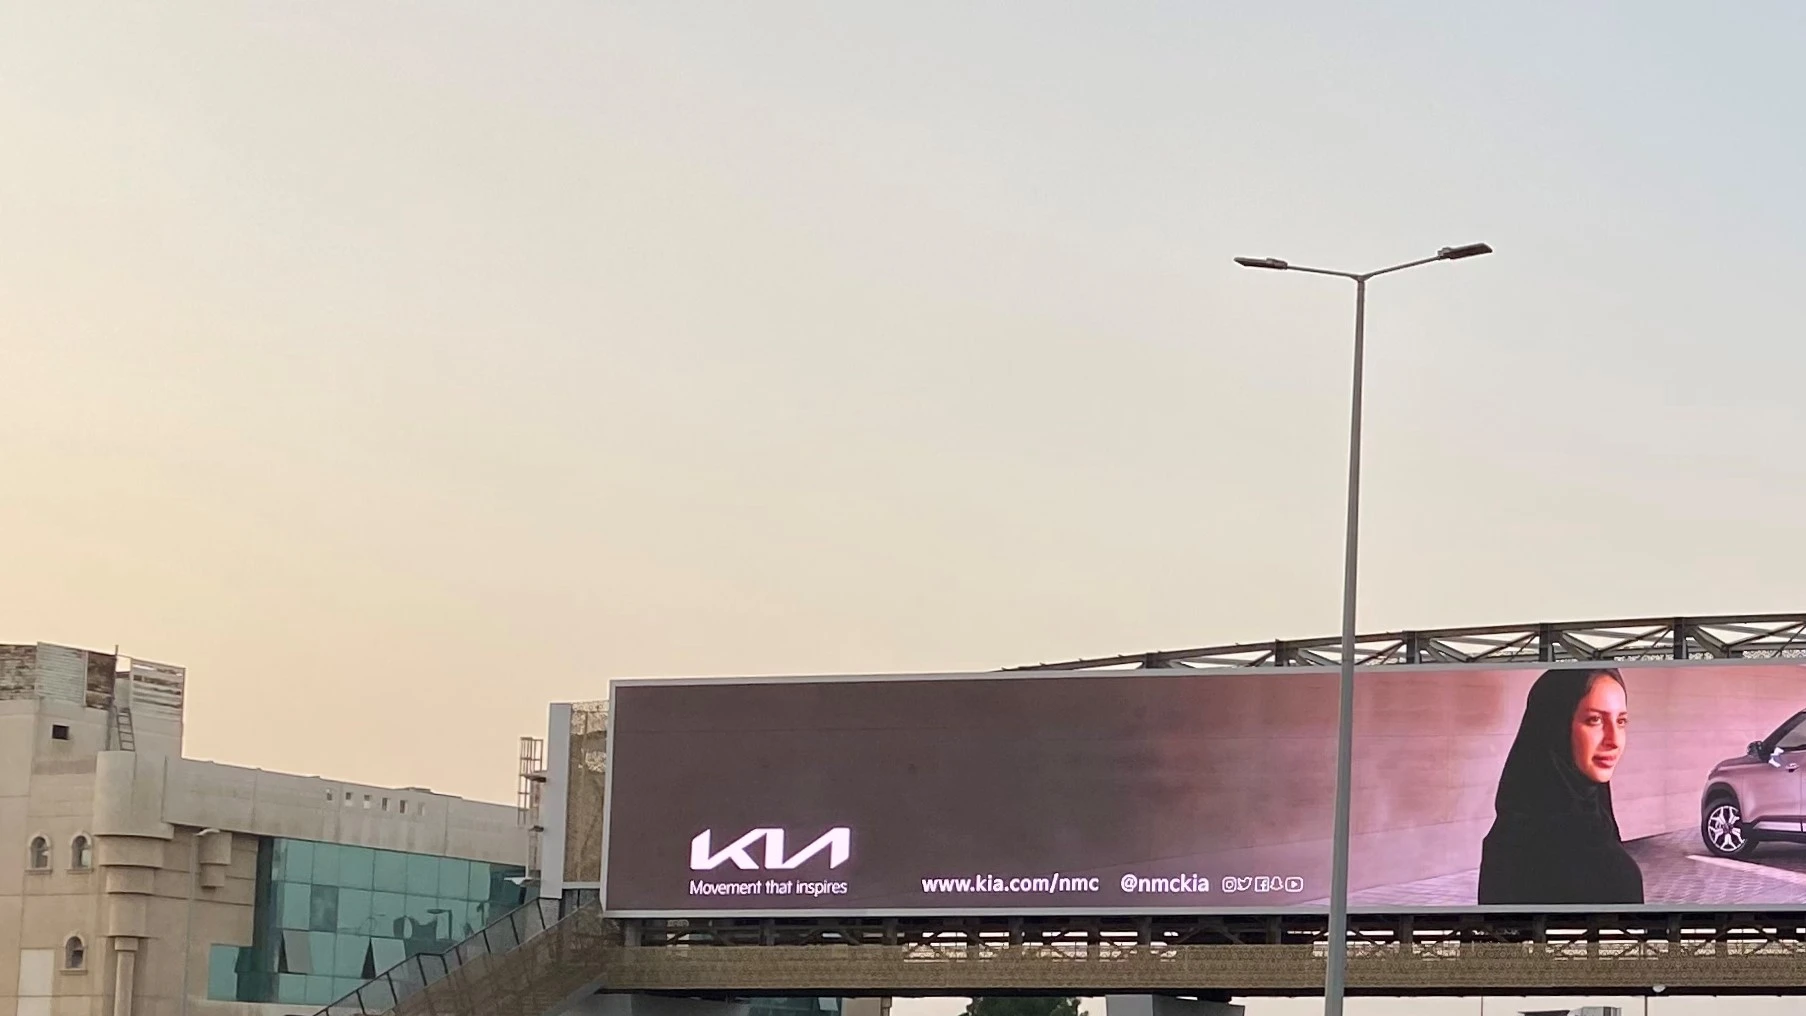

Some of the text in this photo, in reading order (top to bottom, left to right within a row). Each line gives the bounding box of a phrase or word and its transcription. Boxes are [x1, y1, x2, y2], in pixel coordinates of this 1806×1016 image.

[689, 879, 848, 898] Movement that inspires
[921, 872, 1100, 894] www.kia.com/nmc
[1120, 873, 1210, 893] @nmckia
